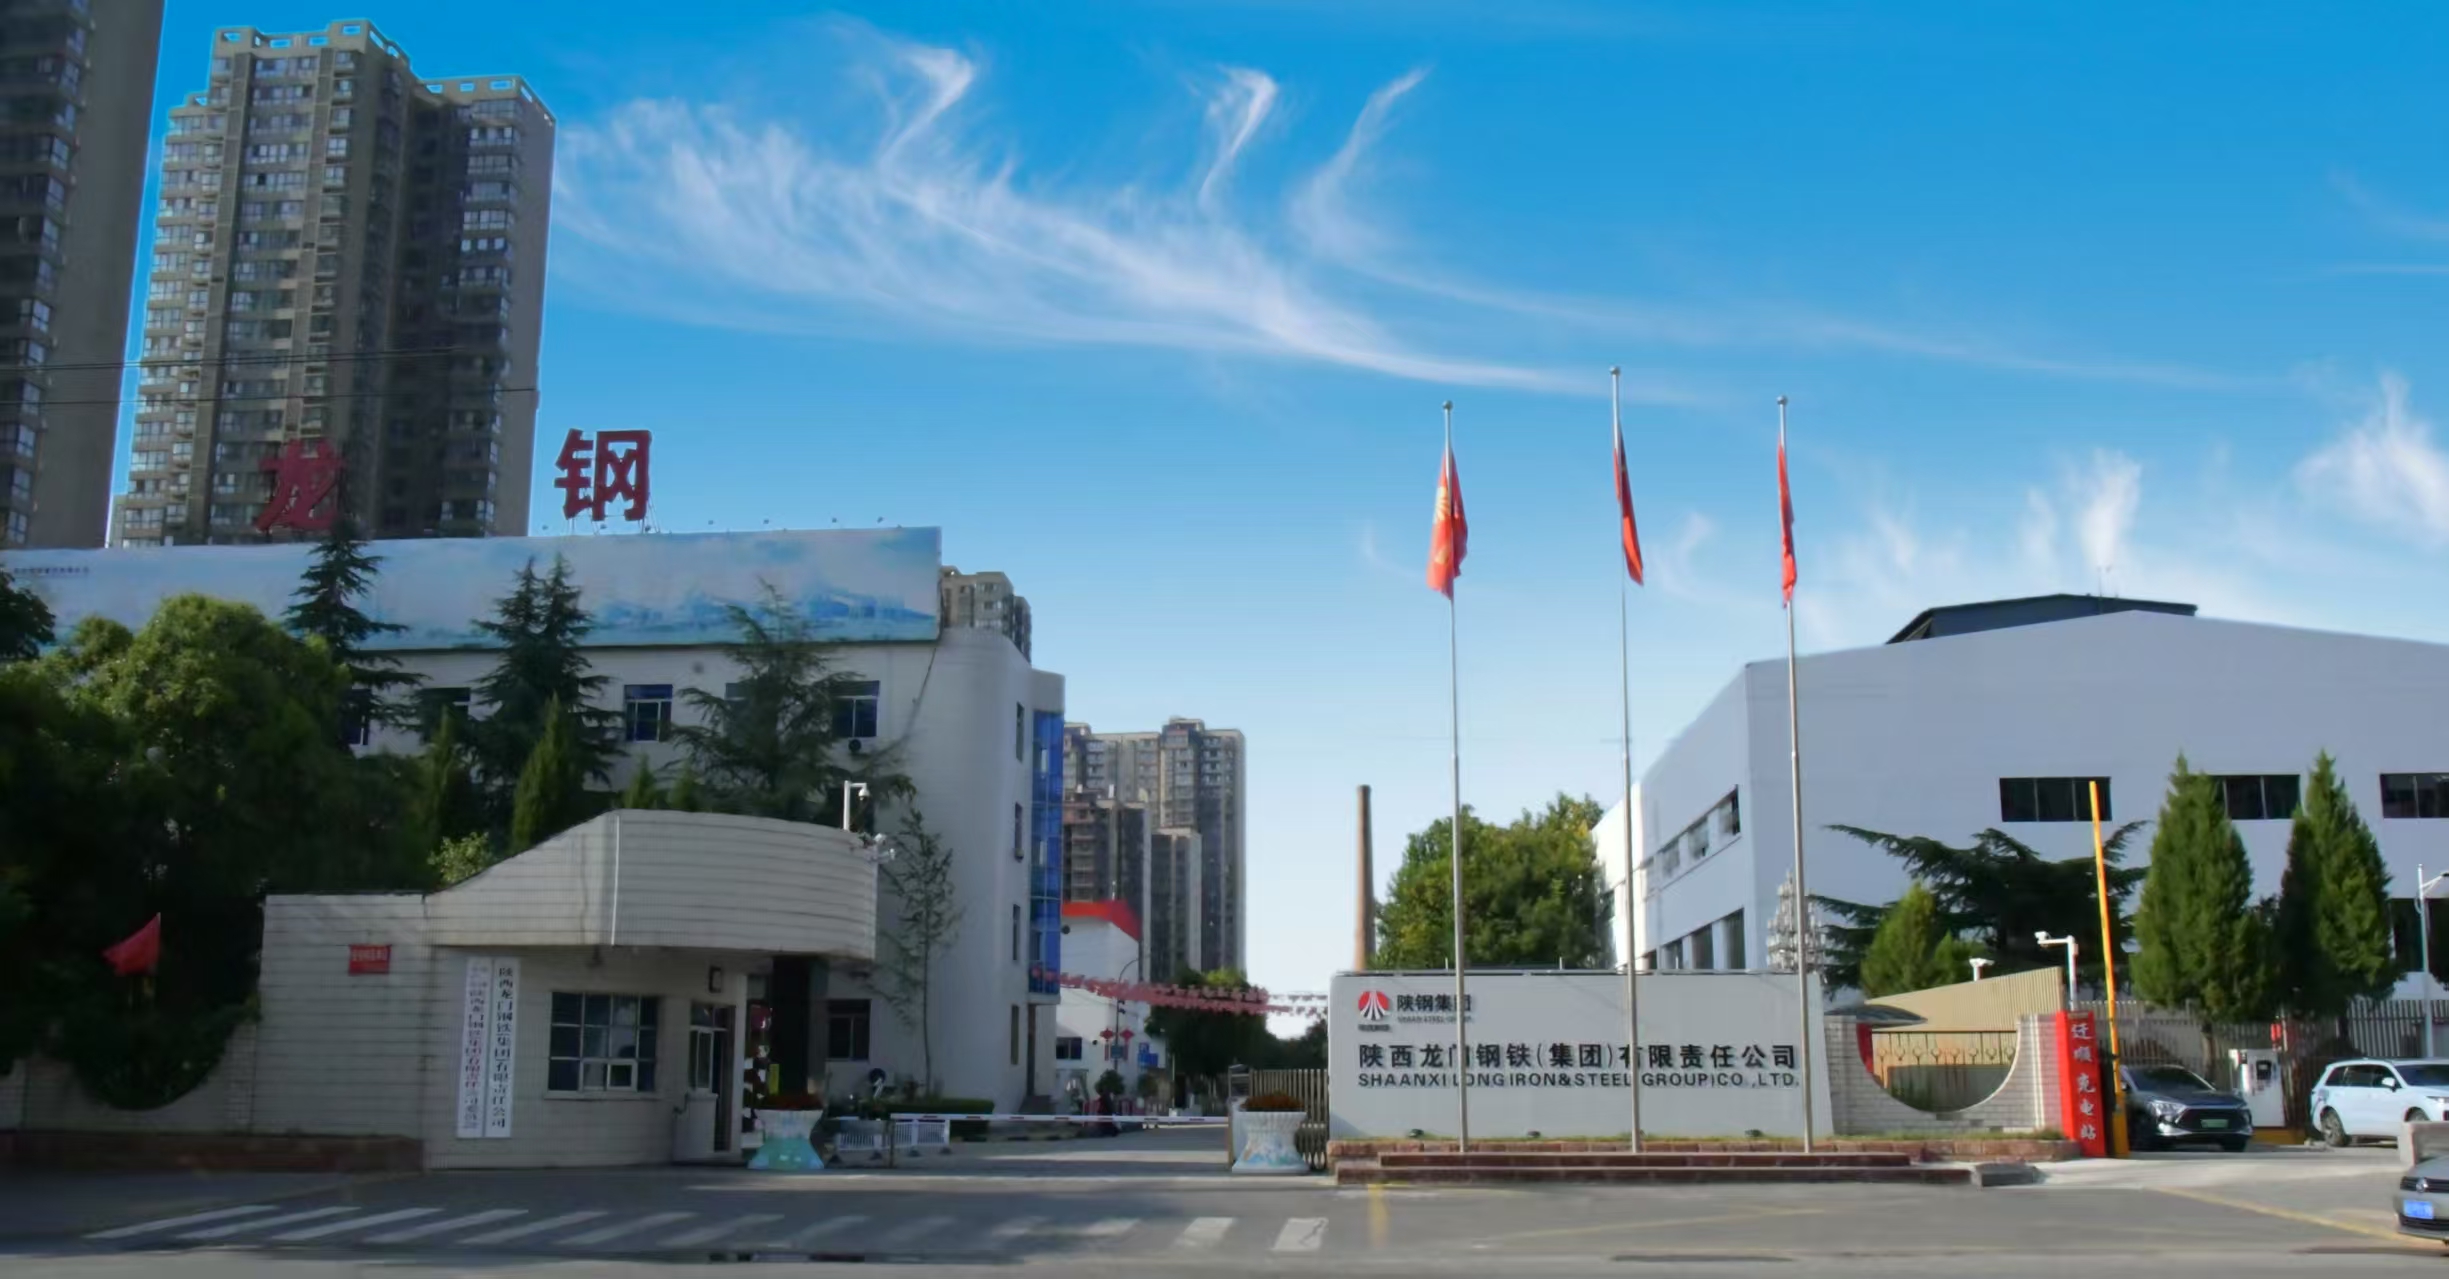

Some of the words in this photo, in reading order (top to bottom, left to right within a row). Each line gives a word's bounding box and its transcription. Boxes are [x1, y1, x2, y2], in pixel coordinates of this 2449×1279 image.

[1359, 1043, 1796, 1069] 陕西龙门钢铁(集团)有限责任公司
[1358, 1073, 1447, 1087] SHAANXI
